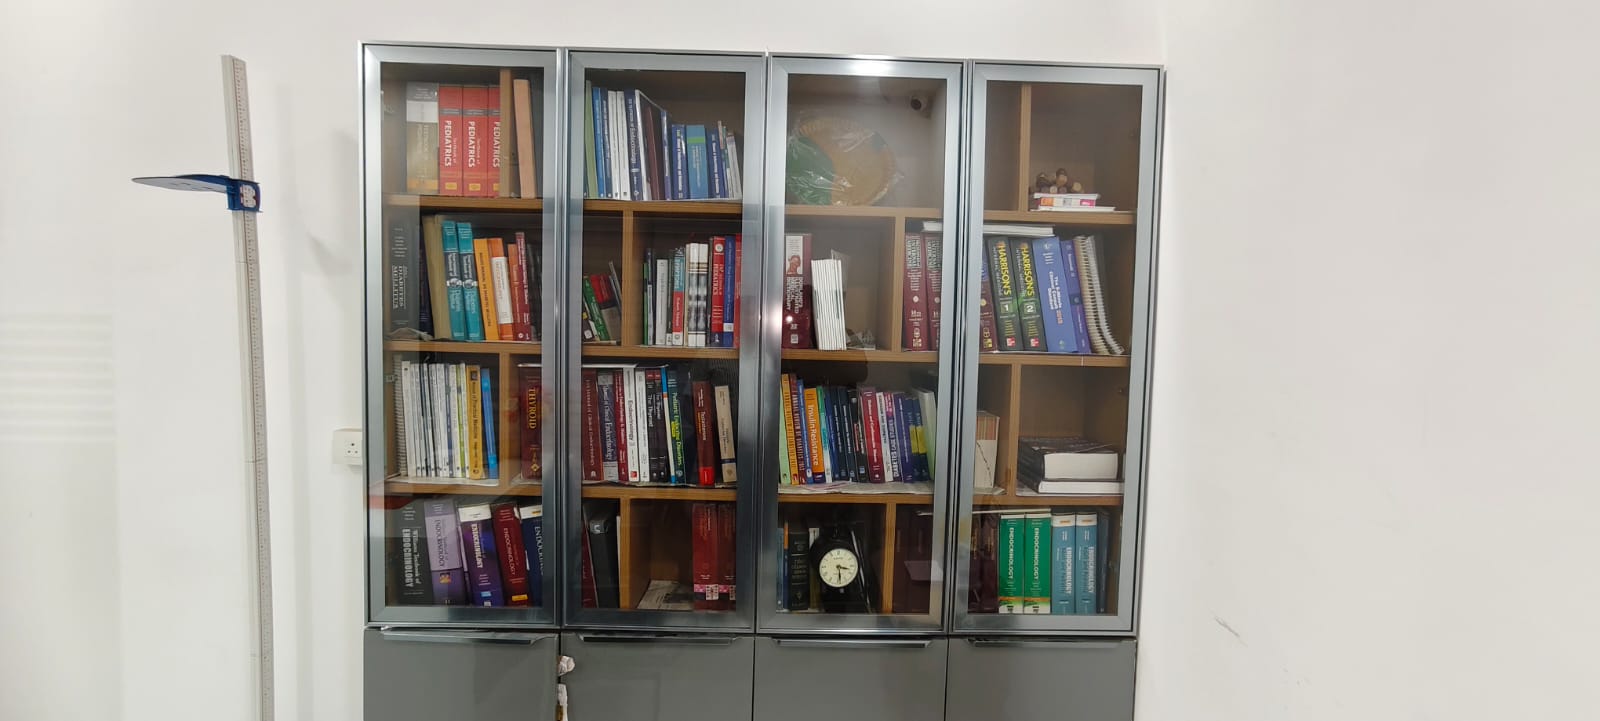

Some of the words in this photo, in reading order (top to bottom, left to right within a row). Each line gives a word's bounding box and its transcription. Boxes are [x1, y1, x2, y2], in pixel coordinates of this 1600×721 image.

[443, 120, 453, 167] PEDIATRICS
[467, 121, 476, 168] PEDIATRICS
[493, 121, 501, 168] PEDIATRICS
[998, 245, 1012, 296] HARRISON'S
[1021, 246, 1035, 296] HARRISON'S
[1027, 304, 1033, 312] 2
[528, 387, 538, 429] THYROID
[627, 399, 635, 441] Endocrinology
[807, 404, 817, 429] Insulin
[604, 422, 613, 461] Endocrinology
[810, 429, 819, 466] Resistance
[889, 439, 897, 451] CASE
[891, 451, 900, 477] DIABETES
[402, 528, 414, 587] ENDOCRINOLOGY
[434, 519, 445, 567] ENDOCRINOLOGY
[471, 523, 483, 568] ENDOCRINOLOGY
[503, 527, 516, 575] ENDOCRINOLOGY
[1087, 546, 1095, 593] ENDOCRINOLOGY
